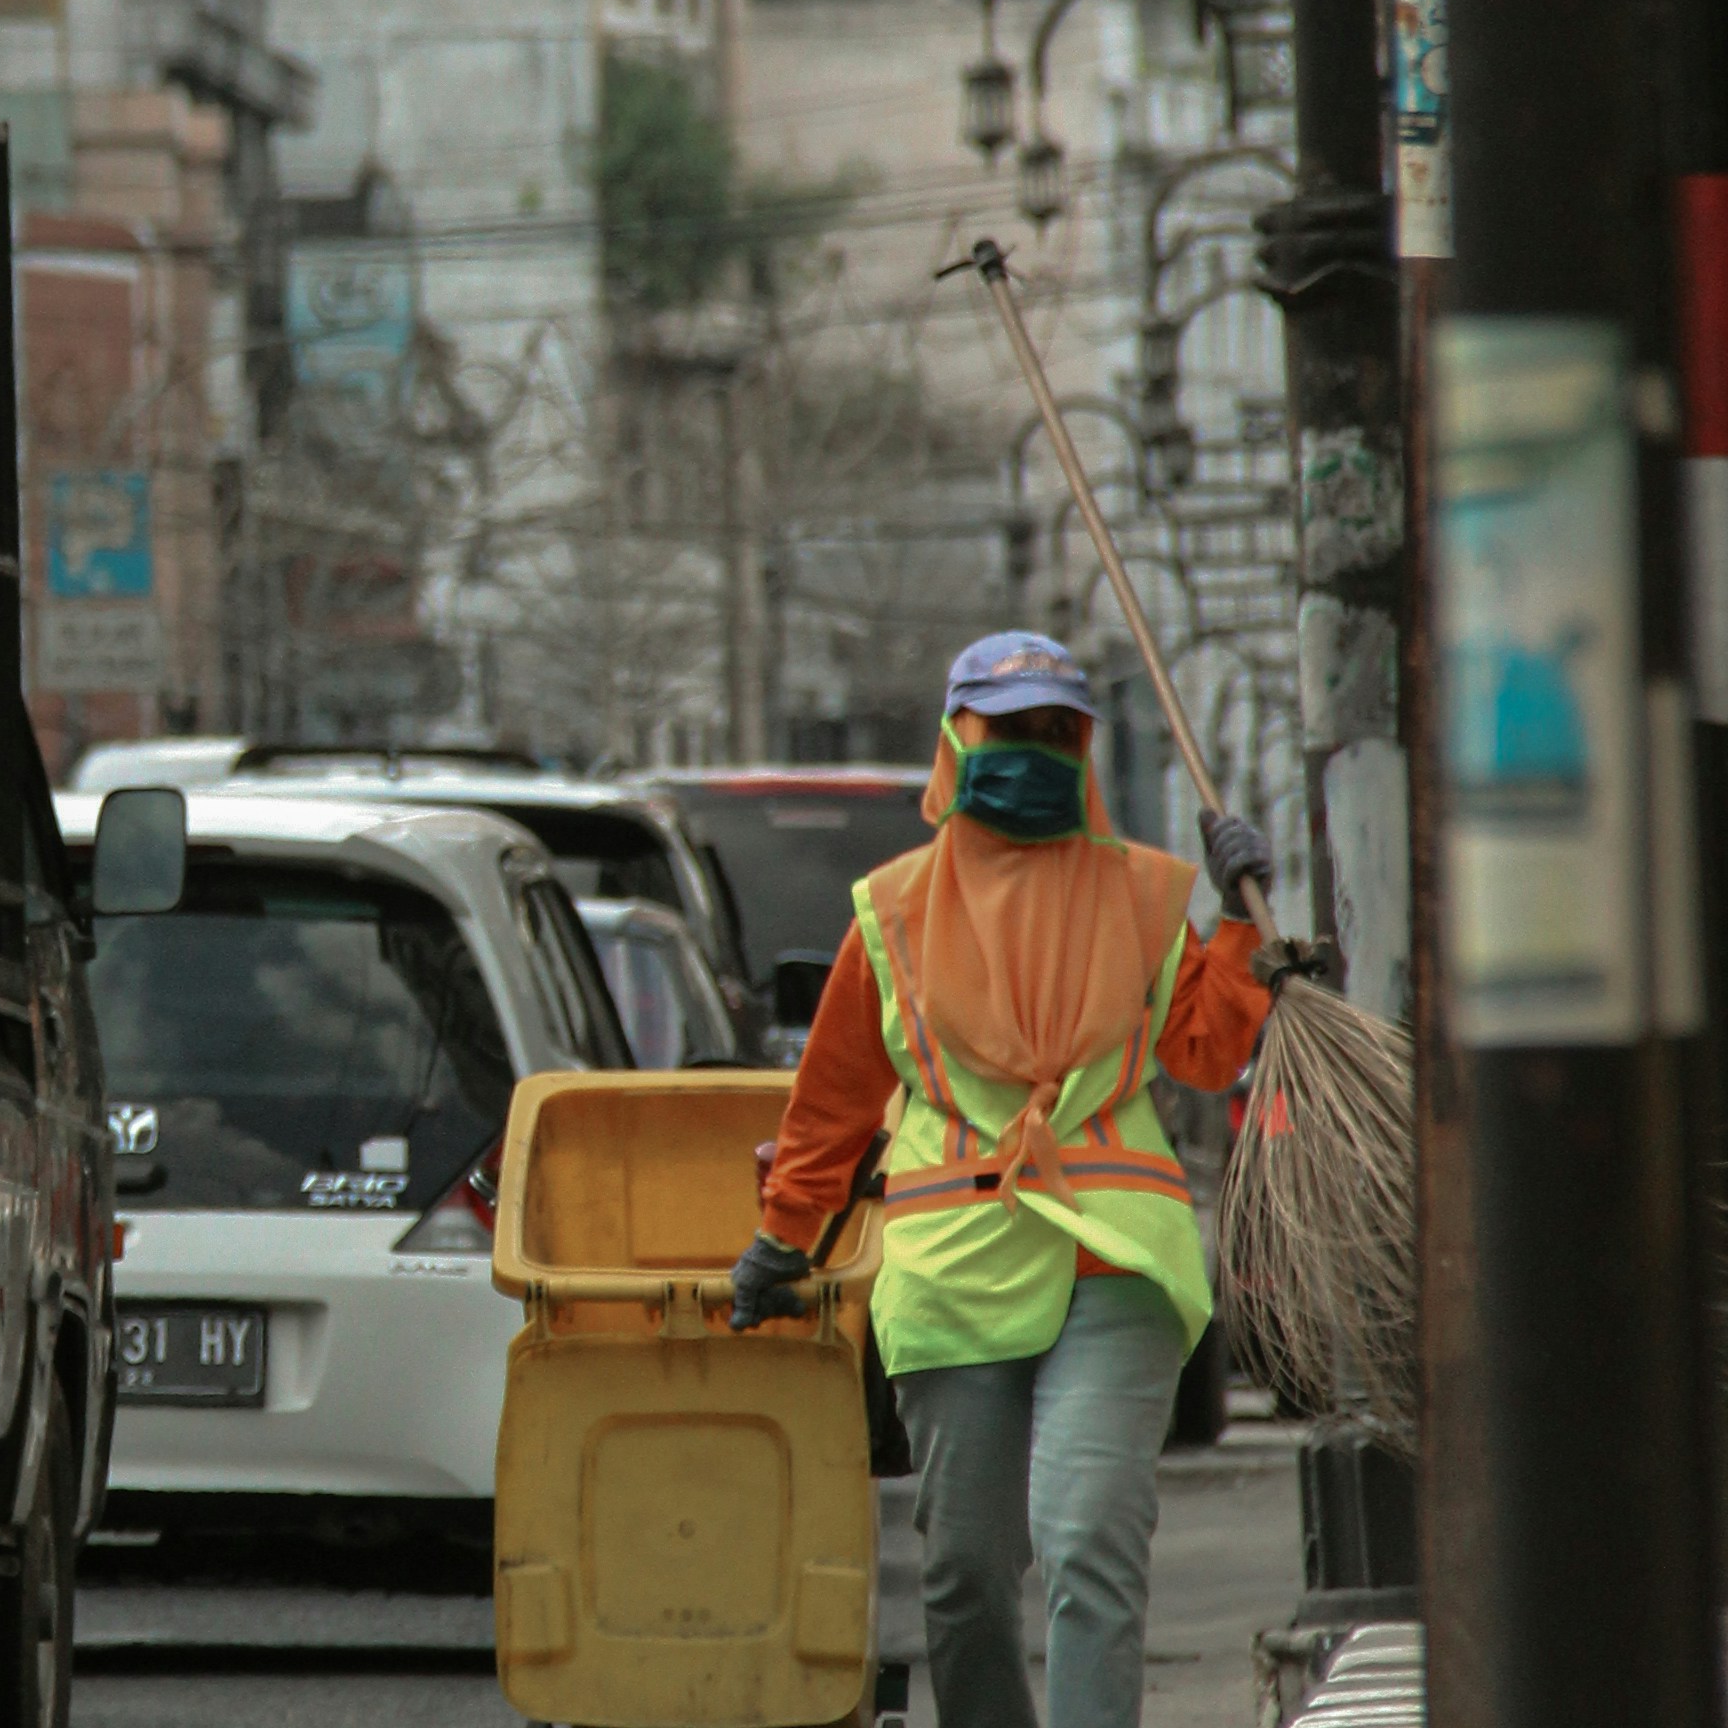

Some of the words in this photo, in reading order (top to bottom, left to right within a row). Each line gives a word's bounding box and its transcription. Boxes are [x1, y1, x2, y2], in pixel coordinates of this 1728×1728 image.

[300, 1172, 410, 1192] BRIO
[309, 1192, 396, 1208] SATYA
[200, 1317, 250, 1366] HY
